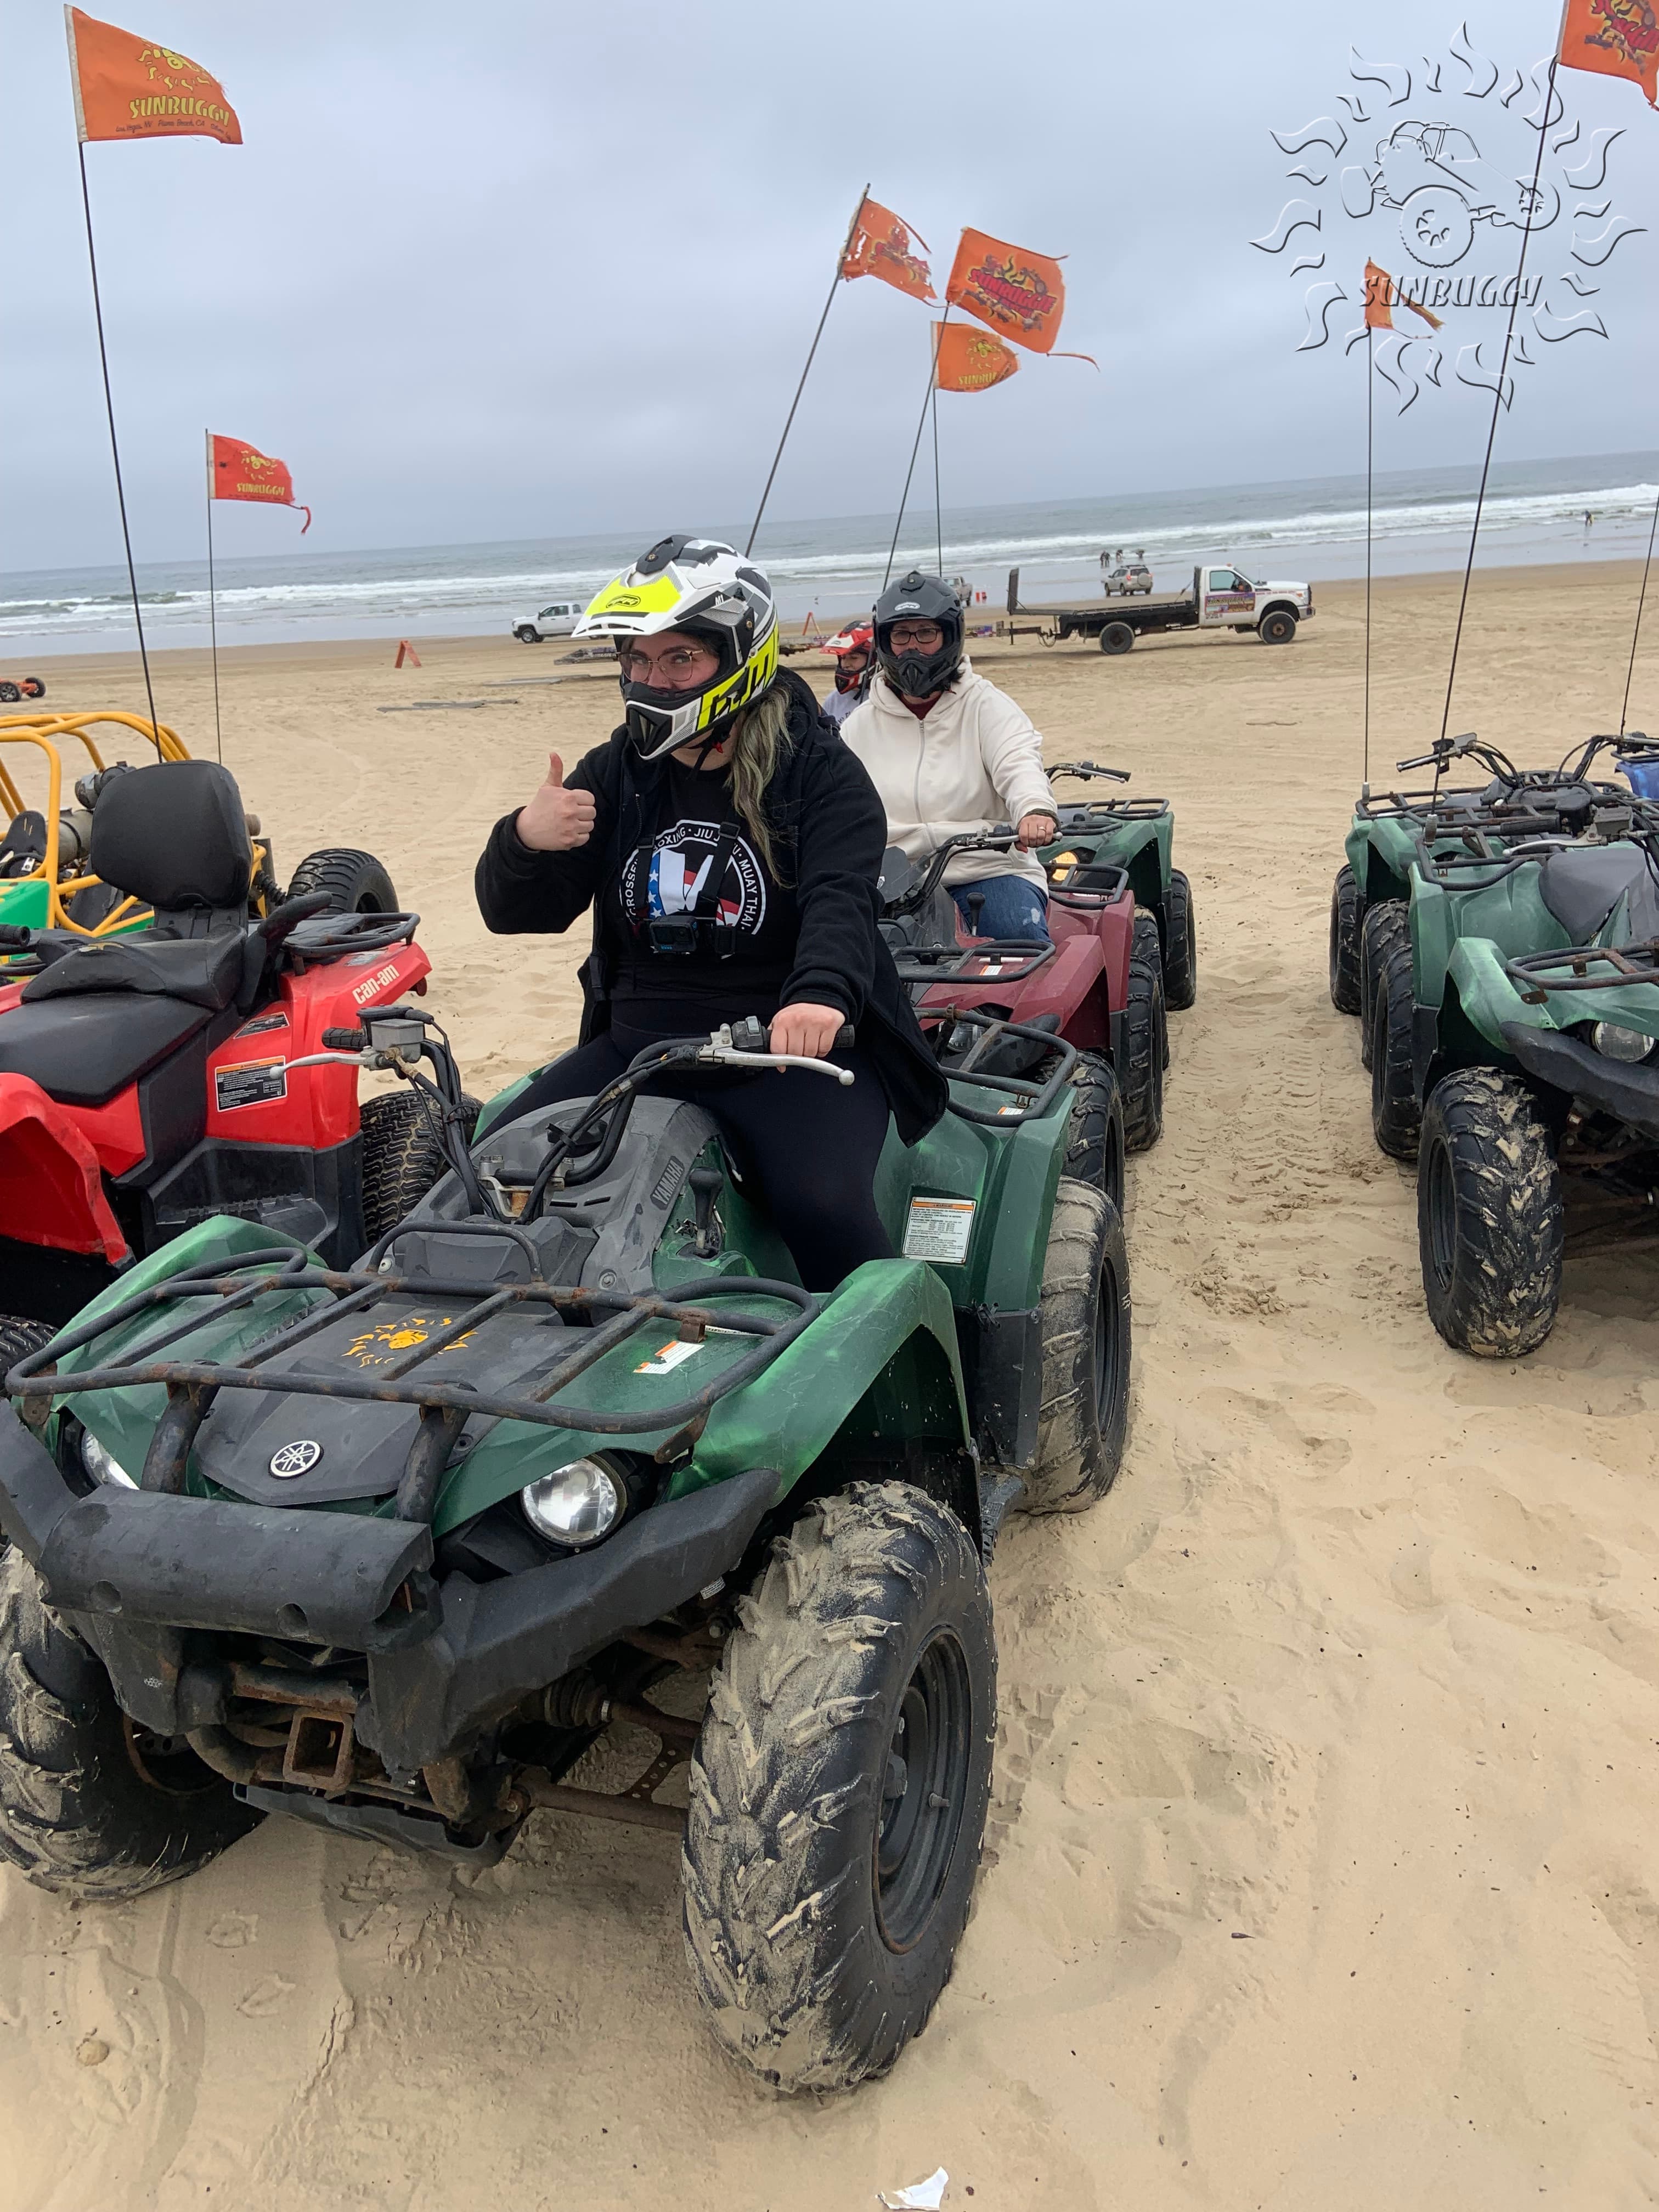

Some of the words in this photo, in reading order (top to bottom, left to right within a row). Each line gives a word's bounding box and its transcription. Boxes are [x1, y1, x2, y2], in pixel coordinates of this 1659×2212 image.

[129, 95, 229, 127] SUNBUGGY
[236, 483, 285, 495] SUNBUGGY
[694, 828, 714, 839] JIU
[738, 859, 758, 894] MUAY
[741, 897, 758, 927] THAI
[352, 964, 400, 1005] can-am
[652, 1159, 684, 1205] YAMAHA
